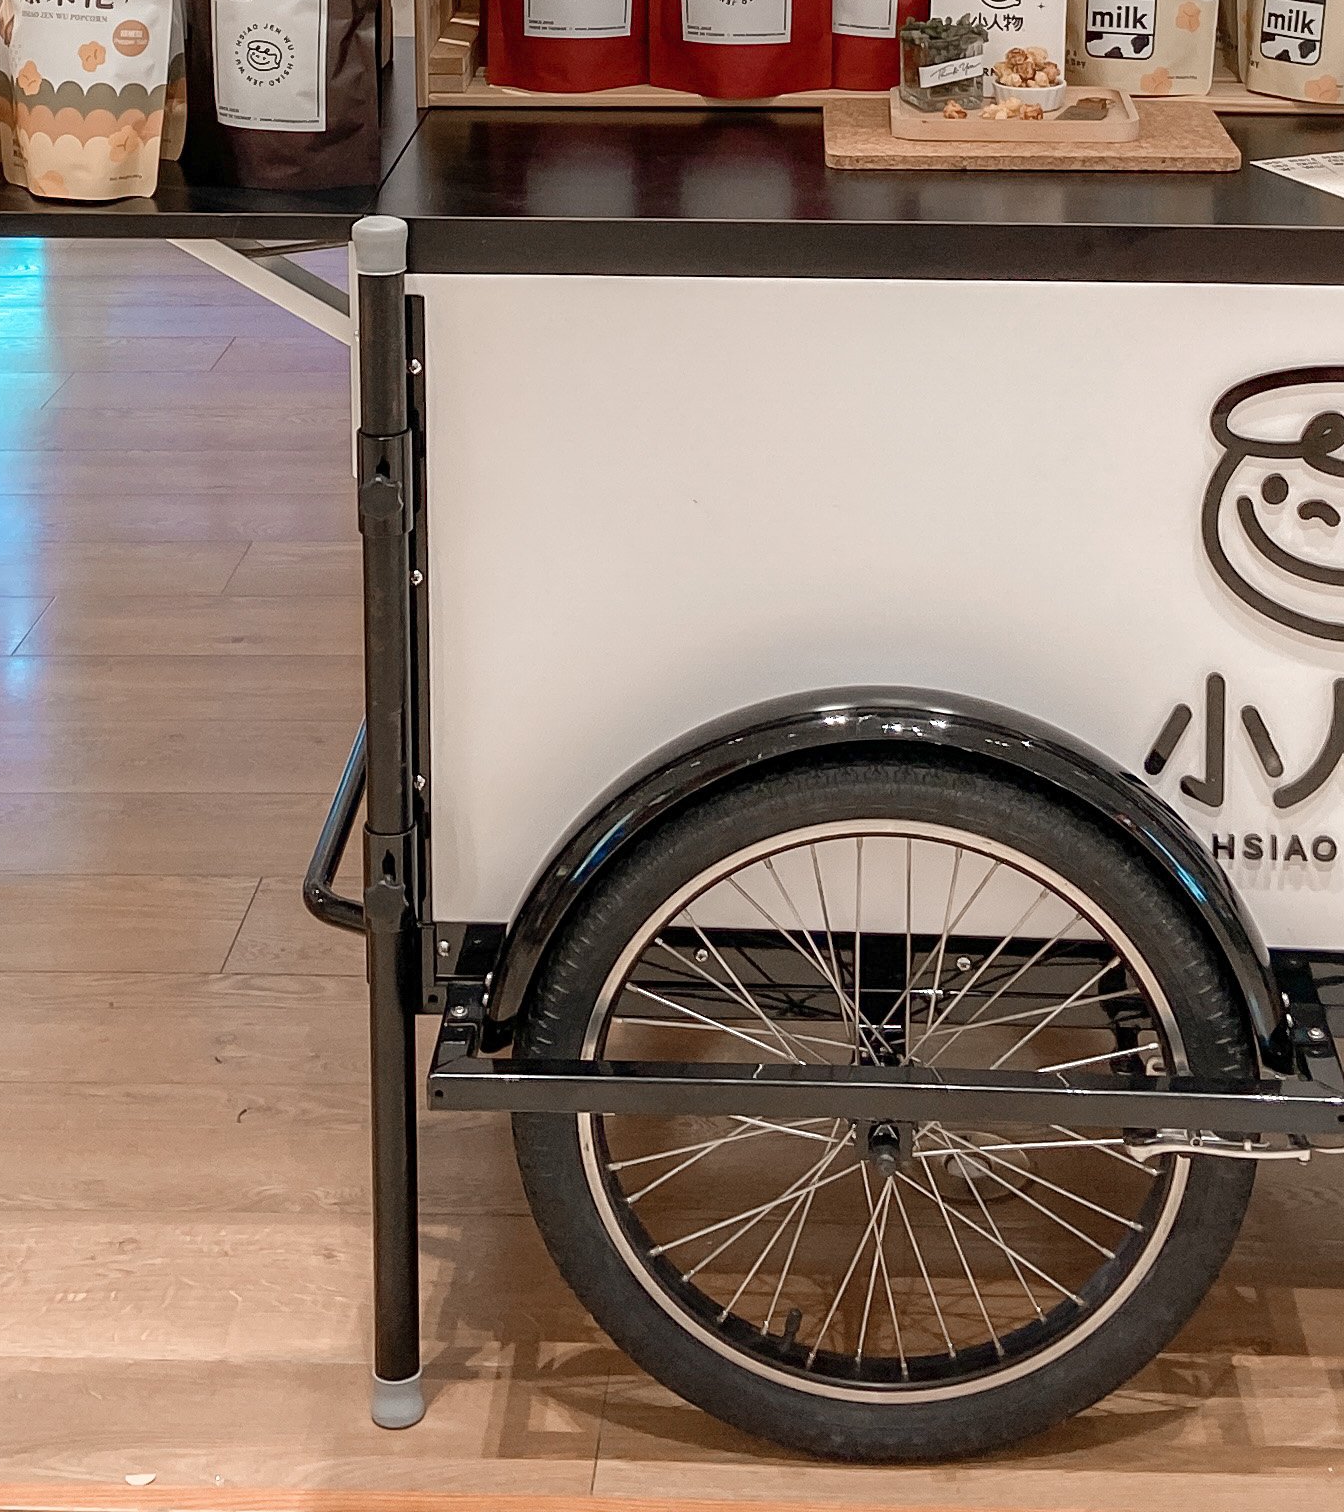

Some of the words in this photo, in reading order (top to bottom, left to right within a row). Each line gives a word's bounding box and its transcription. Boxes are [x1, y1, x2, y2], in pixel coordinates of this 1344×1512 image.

[971, 12, 1024, 32] 小人物
[1091, 5, 1148, 30] milk
[1266, 8, 1316, 36] milk
[1212, 832, 1338, 863] HSIAO
